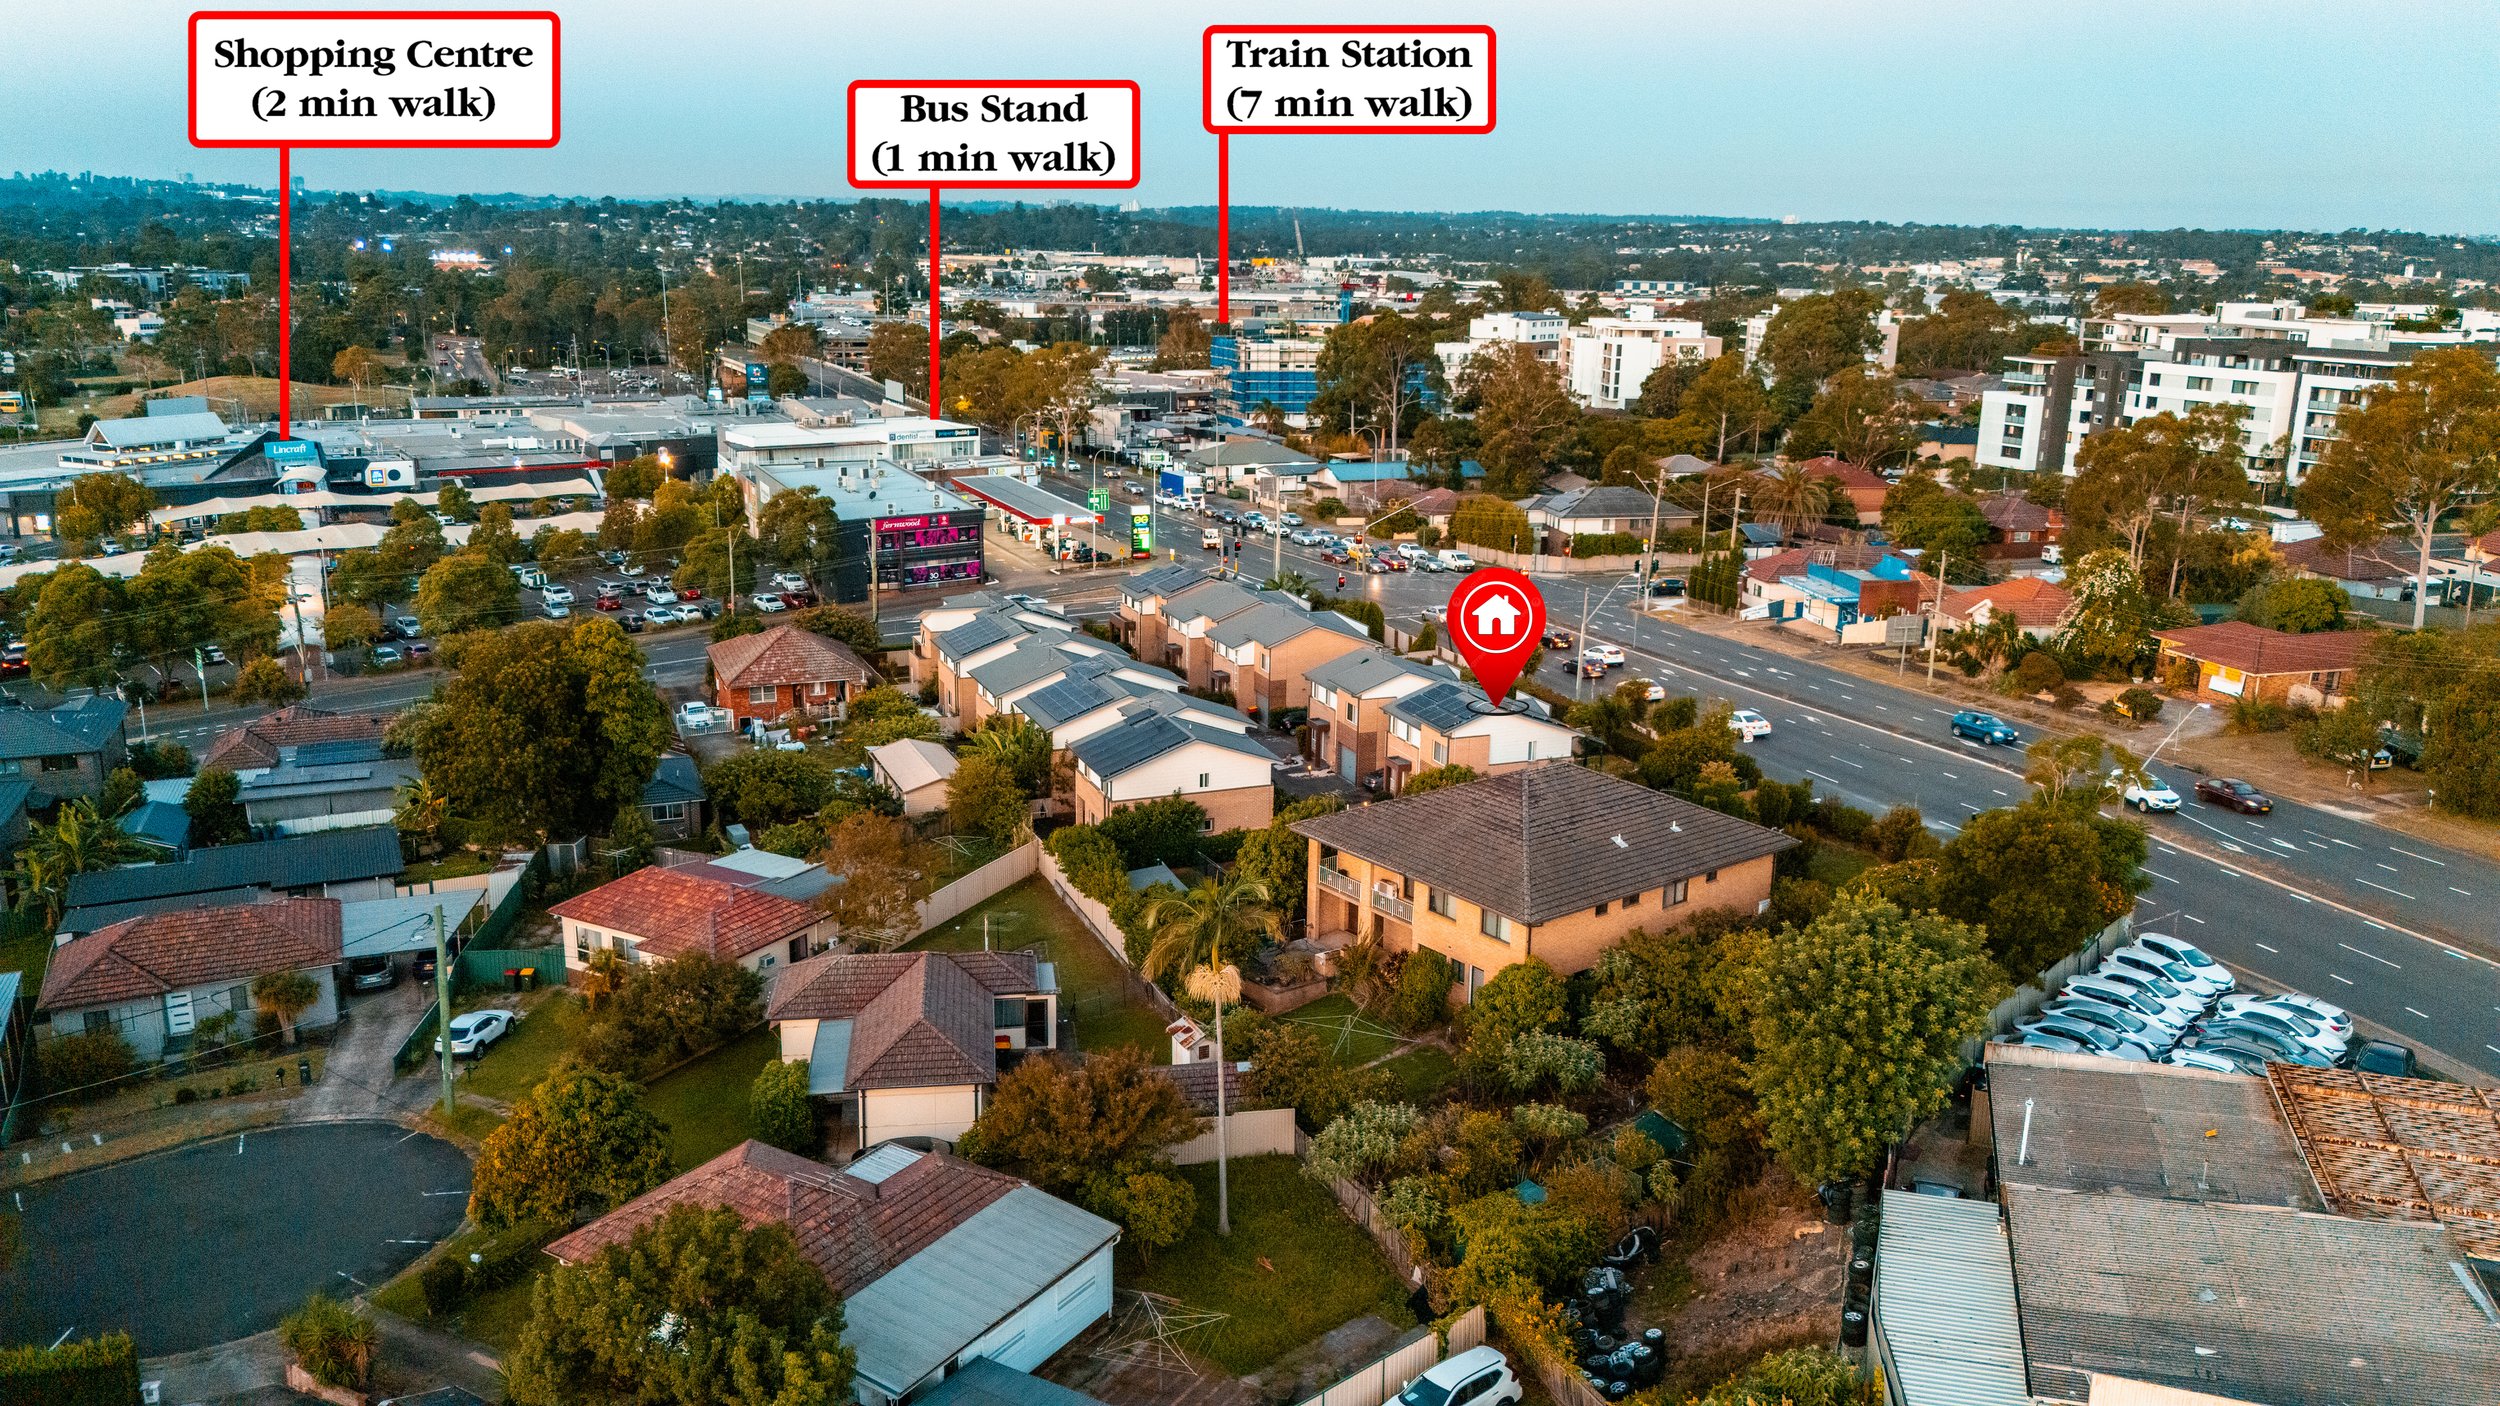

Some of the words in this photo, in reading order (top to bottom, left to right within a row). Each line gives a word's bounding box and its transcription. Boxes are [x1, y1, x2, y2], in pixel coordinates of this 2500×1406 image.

[897, 433, 918, 441] dentist
[273, 443, 307, 454] Lincraft
[881, 518, 921, 530] fernwood
